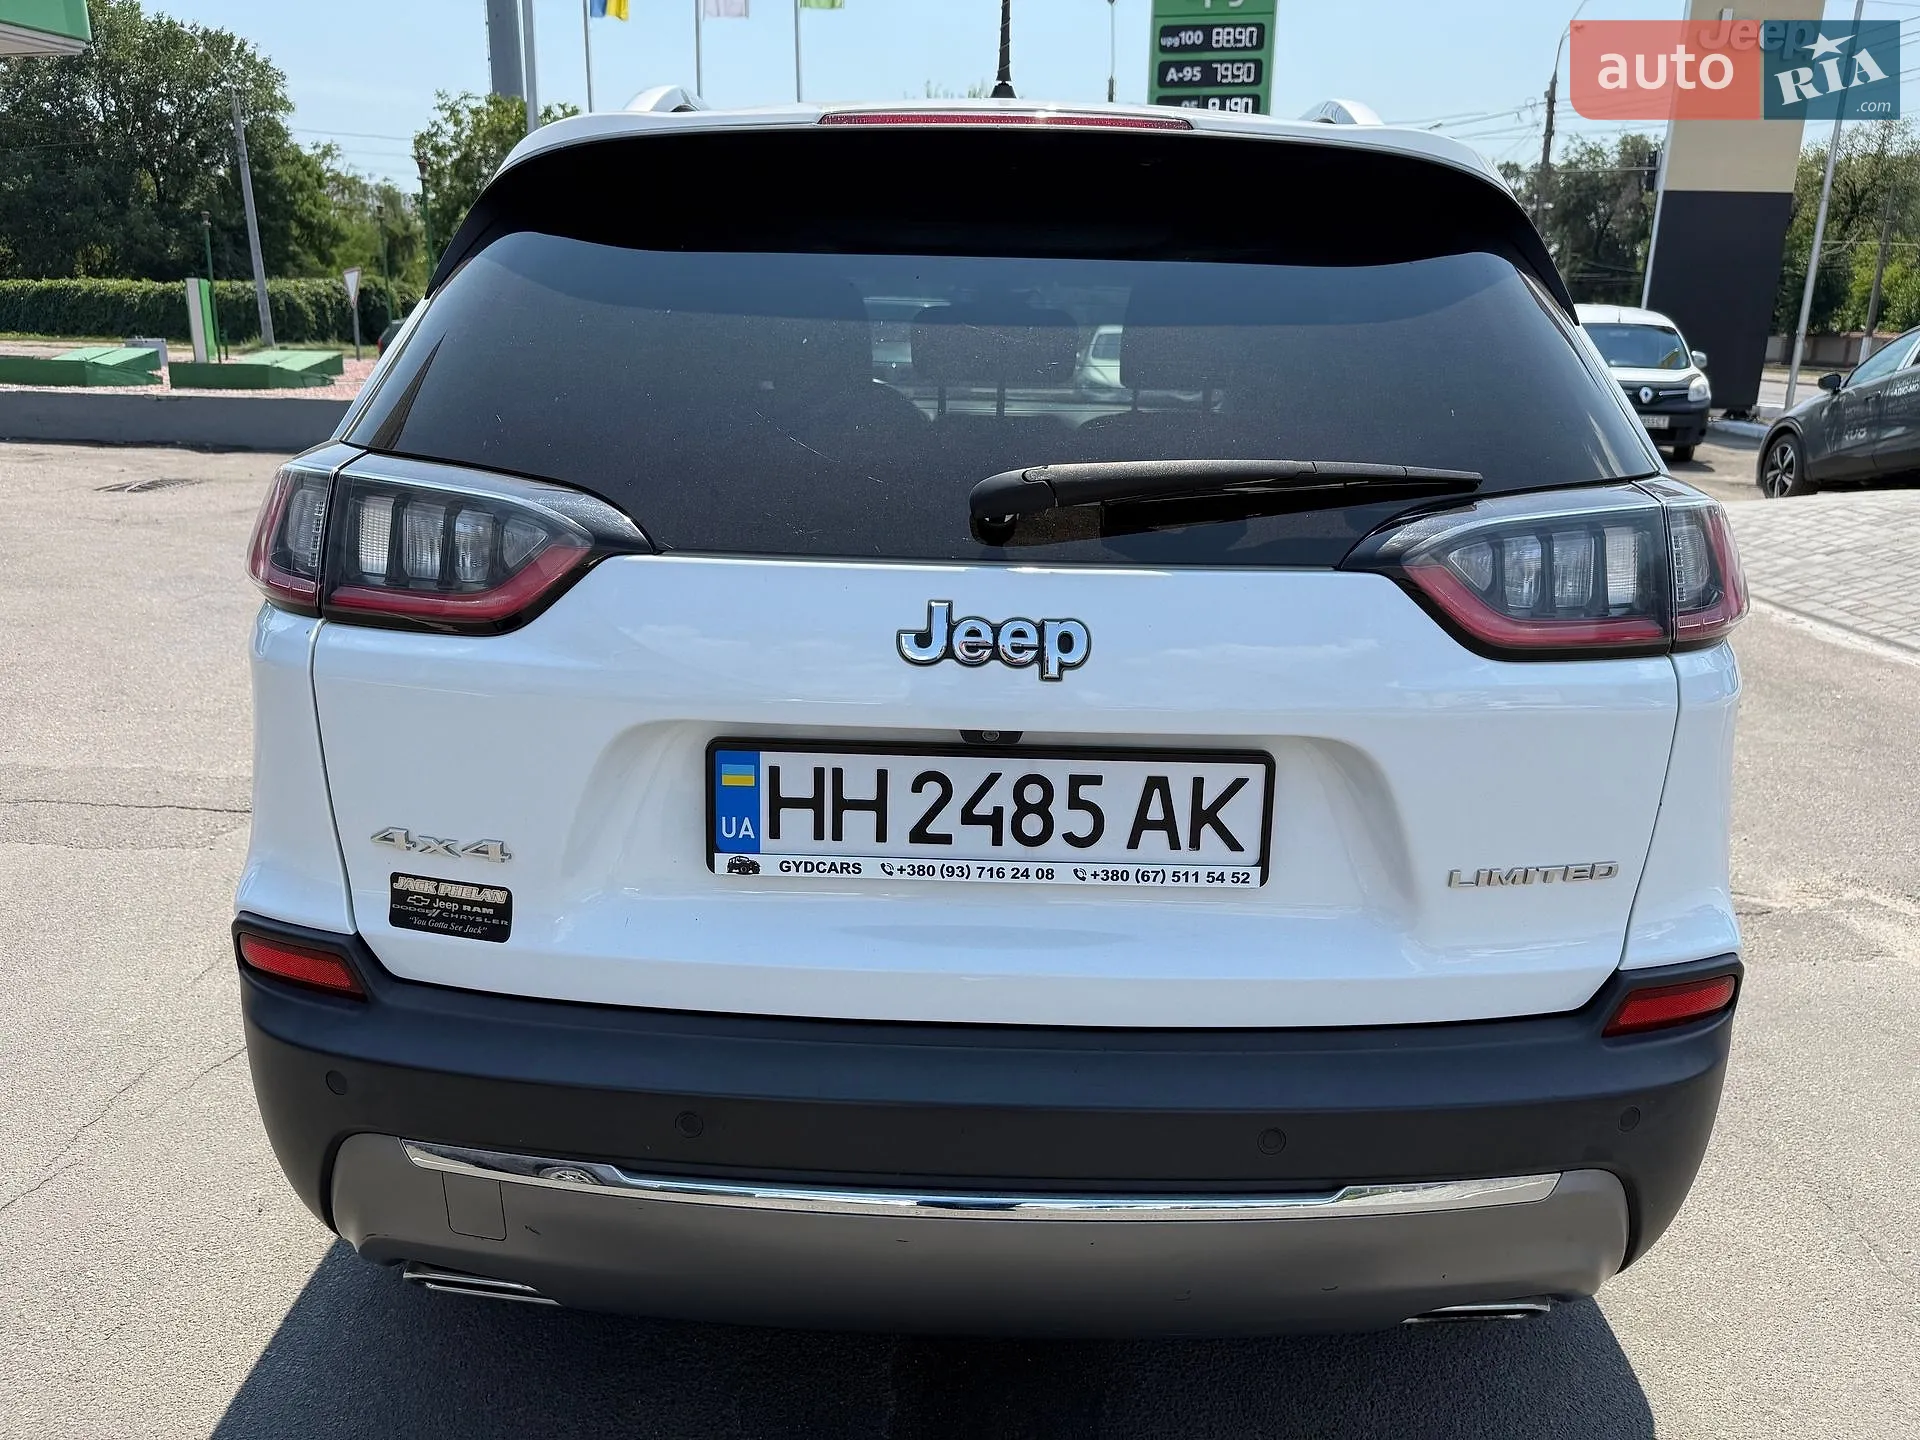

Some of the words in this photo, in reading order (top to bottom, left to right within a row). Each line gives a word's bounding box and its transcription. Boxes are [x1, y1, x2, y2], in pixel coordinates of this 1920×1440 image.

[1160, 30, 1204, 48] upg100
[1165, 66, 1202, 83] A-95
[896, 599, 1092, 682] Jeep
[768, 765, 889, 843] HH
[908, 770, 1105, 849] 2485
[1126, 775, 1250, 852] AK
[720, 816, 755, 839] UA
[778, 860, 863, 875] GYDCARS
[896, 864, 936, 878] +380
[939, 863, 971, 880] (93)
[976, 865, 1006, 879] 716
[1010, 866, 1031, 880] 24
[1034, 867, 1056, 881] 08
[1089, 869, 1131, 882] +380
[1134, 868, 1167, 885] (67)
[1170, 870, 1200, 884] 511
[1205, 871, 1226, 884] 54
[1230, 872, 1251, 885] 52
[1447, 860, 1620, 889] LIMITED
[393, 876, 437, 894] JACK
[438, 882, 507, 904] PHELAN
[391, 903, 434, 916] DODGE
[442, 912, 509, 926] CHRYSLER
[432, 899, 459, 911] Jeep
[462, 904, 494, 915] RAM
[428, 919, 449, 930] Gotta
[449, 922, 463, 933] See
